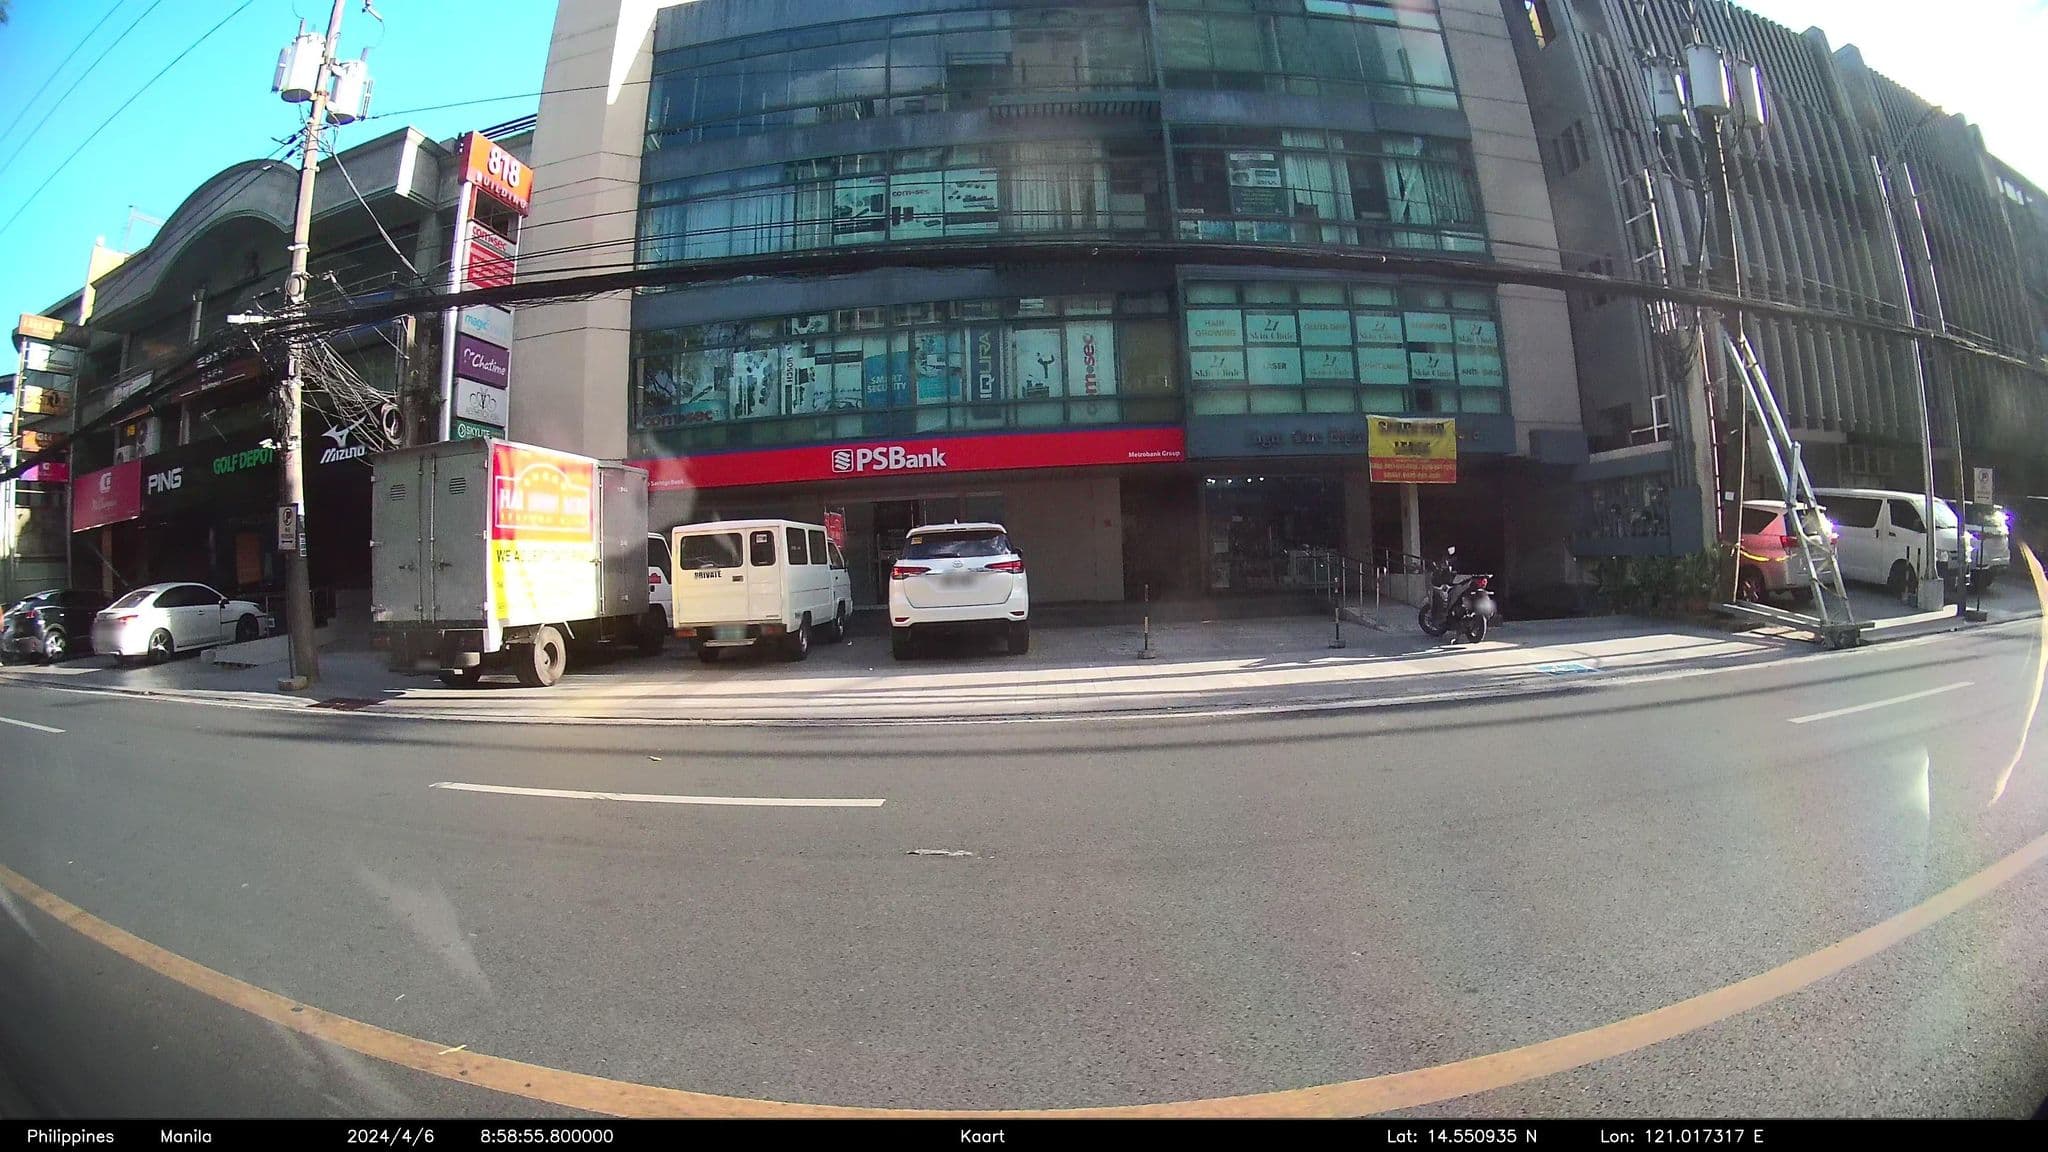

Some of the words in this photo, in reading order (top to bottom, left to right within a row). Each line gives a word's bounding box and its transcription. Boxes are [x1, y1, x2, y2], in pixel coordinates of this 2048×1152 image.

[488, 145, 520, 189] 818
[475, 171, 529, 209] BUILDING
[471, 354, 506, 376] Chatime
[867, 382, 907, 394] SECUITY
[871, 374, 903, 384] SMRT
[213, 455, 238, 475] GOLF
[239, 447, 274, 469] DEPOT
[320, 445, 367, 464] MIZUNO
[855, 446, 947, 472] PSBank
[1161, 450, 1181, 458] Group
[148, 467, 183, 495] PING
[694, 570, 722, 580] PRIVATE
